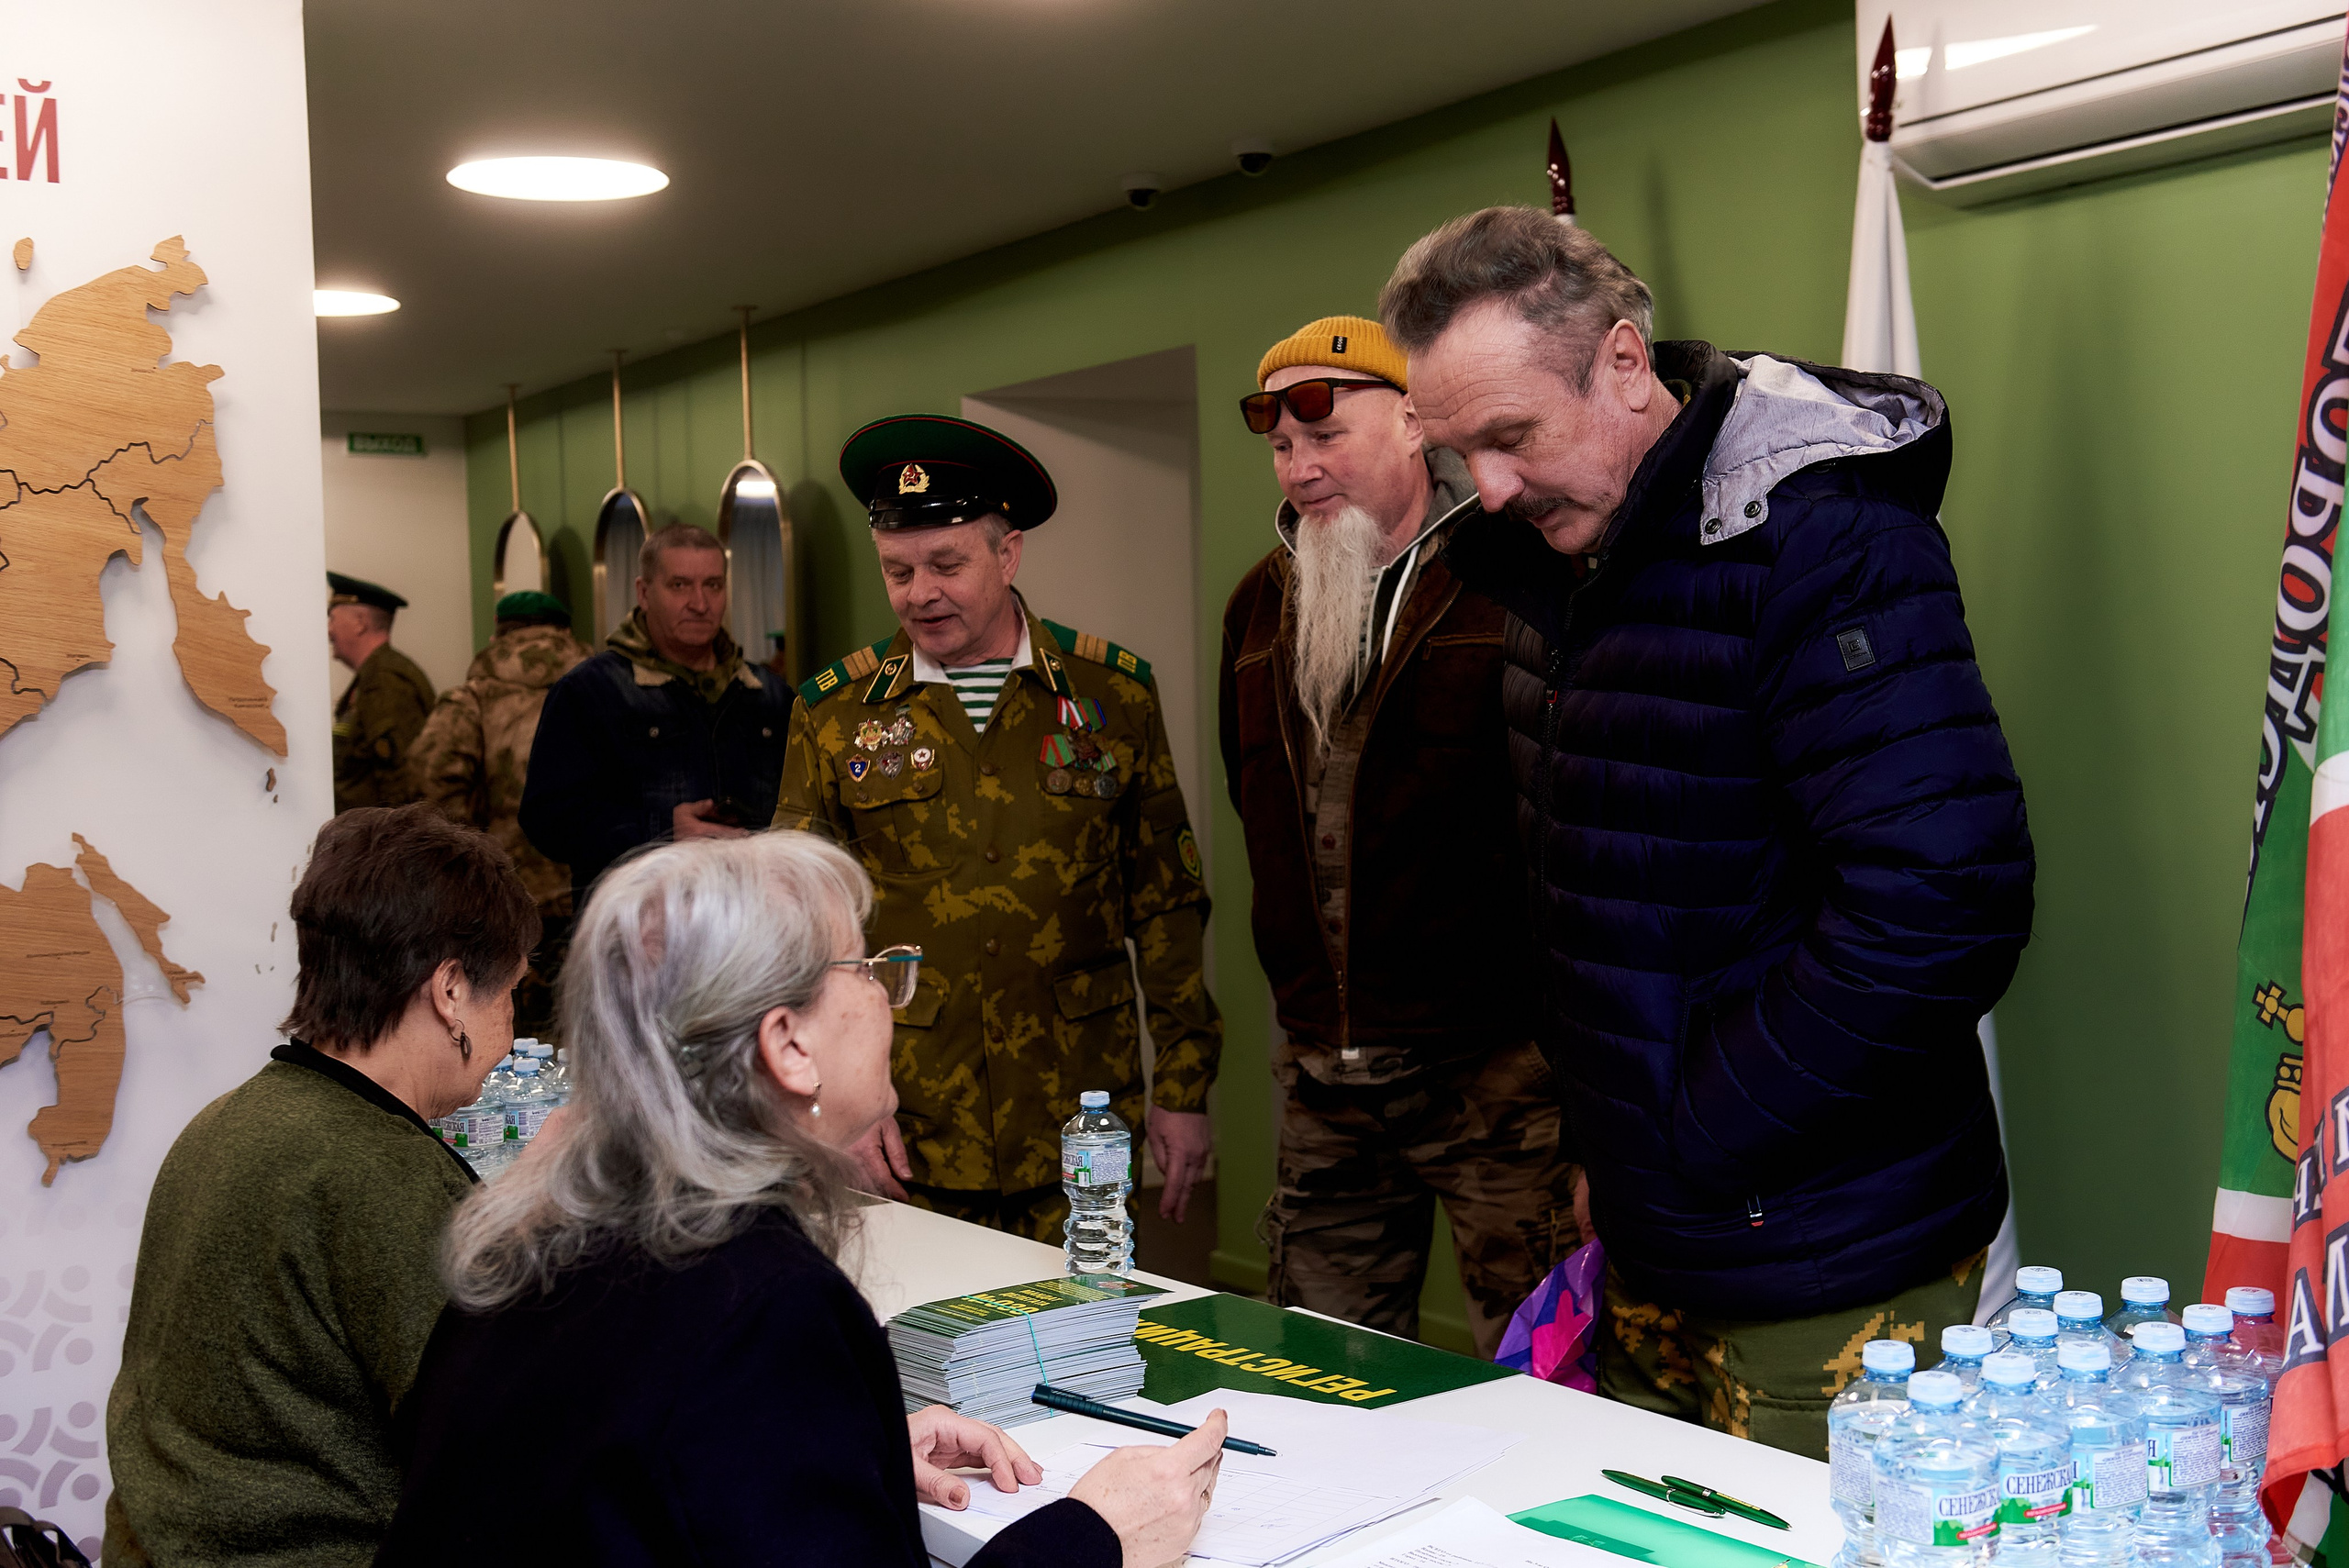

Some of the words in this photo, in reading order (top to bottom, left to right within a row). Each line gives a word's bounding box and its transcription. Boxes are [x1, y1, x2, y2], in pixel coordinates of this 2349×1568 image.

[0, 78, 60, 183] Й
[815, 667, 839, 692] ПВ
[854, 763, 862, 773] 2
[1133, 1318, 1397, 1401] РЕГИСТРАЦИ
